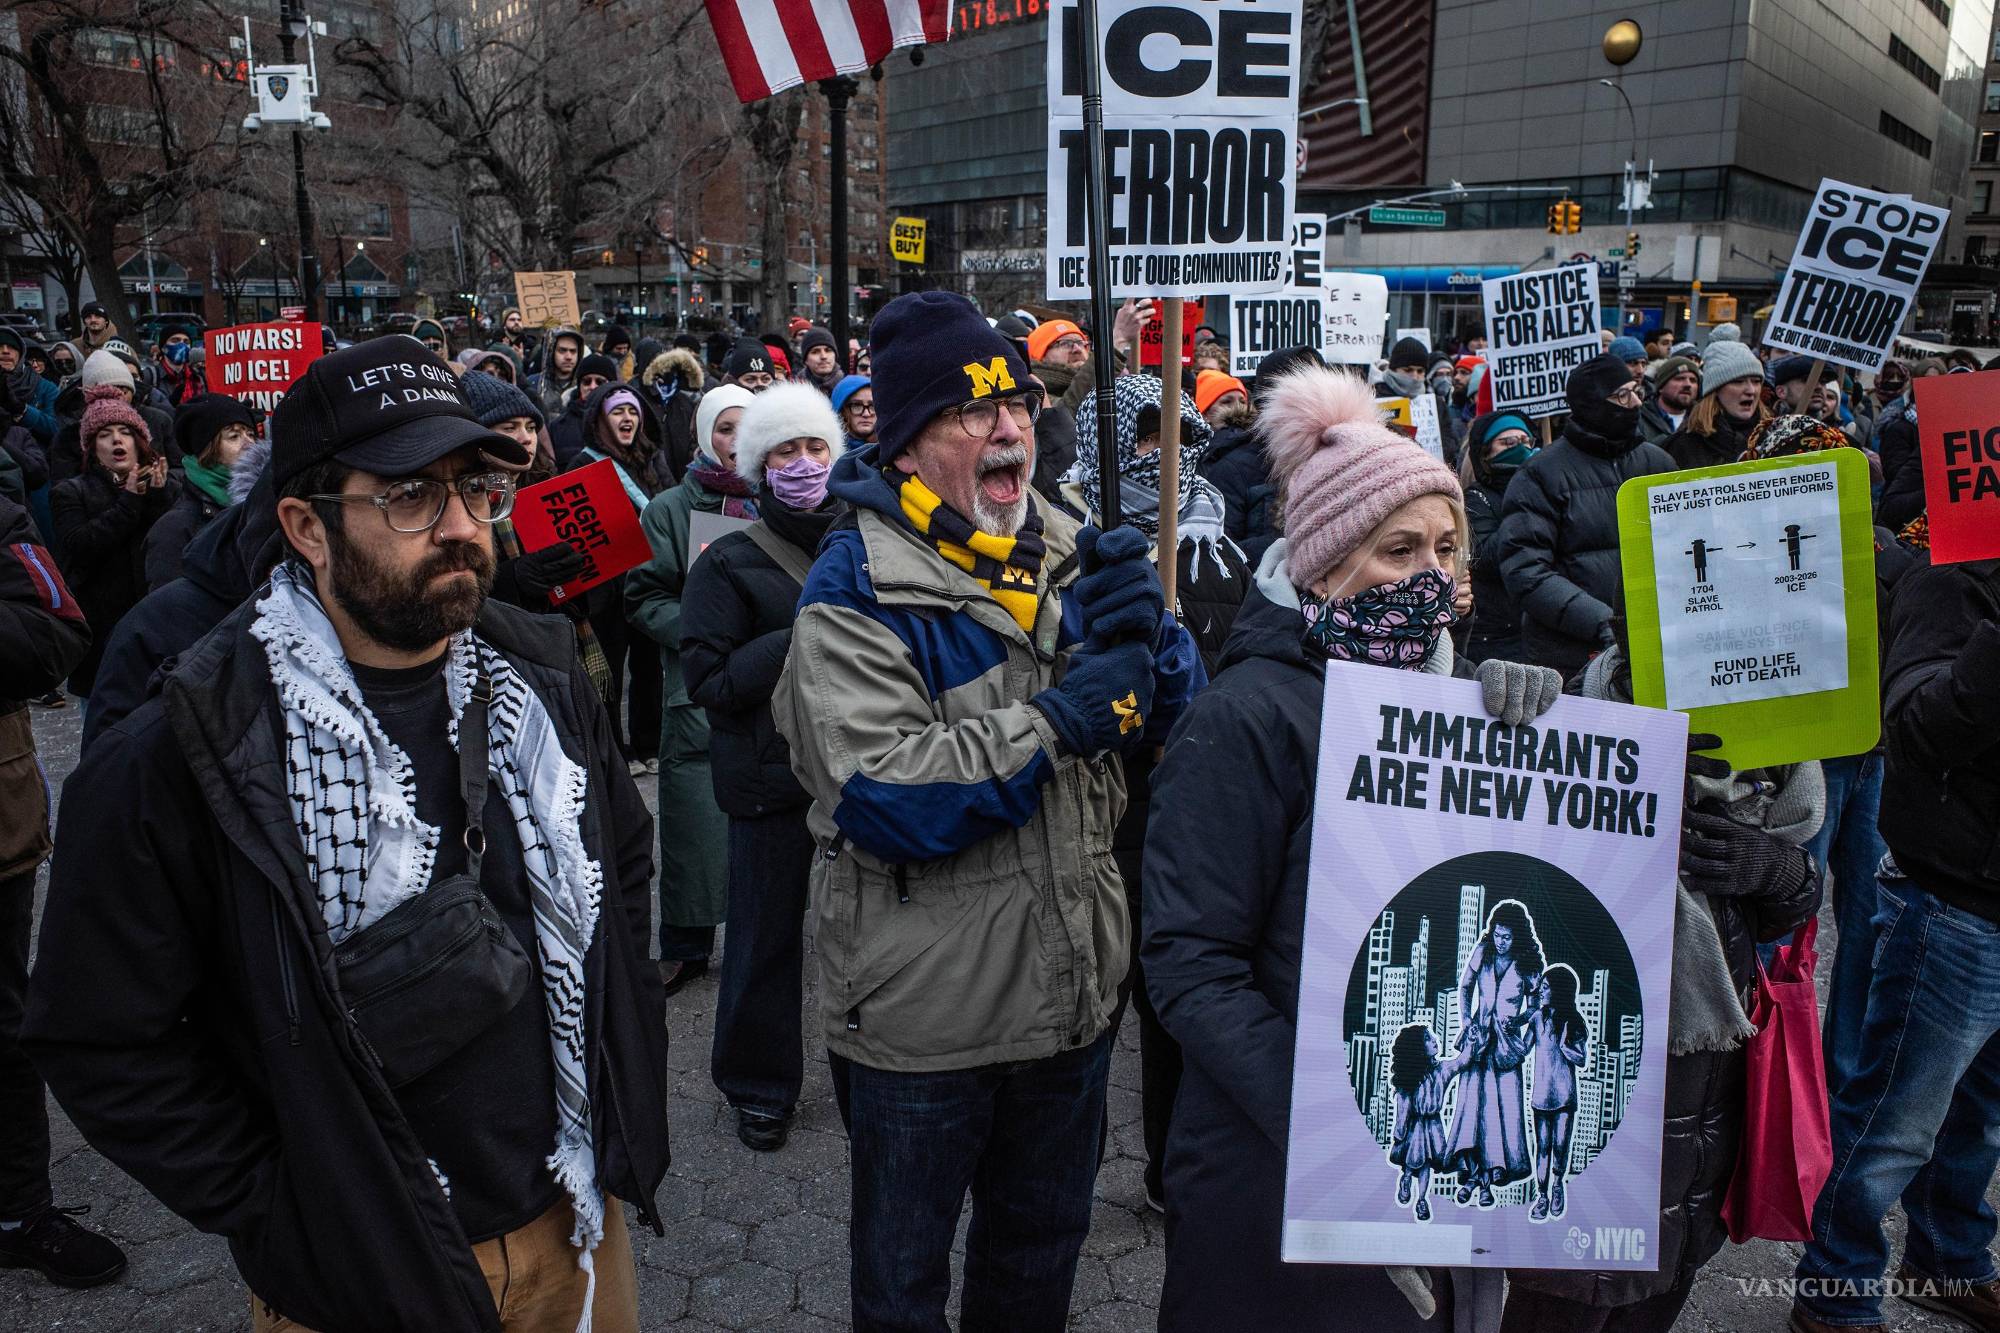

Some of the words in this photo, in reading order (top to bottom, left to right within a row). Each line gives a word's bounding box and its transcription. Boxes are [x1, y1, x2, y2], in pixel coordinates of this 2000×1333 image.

[1062, 6, 1292, 98] ICE
[1059, 128, 1286, 247] TERROR
[1818, 189, 1940, 239] STOP
[895, 224, 924, 240] BEST
[895, 239, 920, 255] BUY
[1801, 216, 1930, 286] ICE
[1059, 256, 1085, 288] ICE
[1122, 254, 1143, 286] OF
[1145, 254, 1181, 286] OUR
[1182, 250, 1282, 284] COMMUNITIES
[159, 283, 182, 294] Office
[520, 279, 550, 325] ICE!
[1495, 267, 1590, 315] JUSTICE
[1235, 299, 1322, 353] TERROR
[1492, 311, 1539, 349] FOR
[1542, 302, 1596, 342] ALEX
[1780, 269, 1906, 350] TERROR
[215, 332, 235, 356] NO
[236, 327, 303, 351] WARS!
[1770, 326, 1784, 343] ICE
[1784, 329, 1802, 347] OUT
[1800, 333, 1812, 350] OF
[1811, 336, 1832, 356] OUR
[1829, 341, 1882, 368] COMMUNITIES
[224, 361, 243, 385] NO
[247, 359, 290, 382] ICE!
[420, 363, 457, 389] GIVE
[1236, 355, 1247, 371] ICE
[1247, 355, 1259, 371] OUT
[1494, 351, 1552, 378] JEFFREY
[1553, 342, 1599, 367] PRETTI
[963, 356, 1017, 398] M
[1496, 374, 1548, 403] KILLED
[1549, 370, 1568, 396] BY
[380, 392, 398, 410] A
[402, 386, 461, 405] DAMN
[1651, 502, 1686, 515] THEY
[1683, 498, 1712, 511] JUST
[1714, 490, 1771, 506] CHANGED
[1774, 481, 1835, 498] UNIFORMS
[1653, 490, 1695, 504] SLAVE
[1693, 482, 1746, 499] PATROLS
[1749, 477, 1788, 491] NEVER
[1790, 471, 1831, 485] ENDED
[562, 482, 611, 550] FIGHT
[1001, 562, 1036, 586] M
[1690, 584, 1715, 595] 1704
[1774, 571, 1818, 585] 2003-2026
[1787, 581, 1807, 593] ICE
[1685, 602, 1724, 614] PATROL
[1688, 595, 1719, 606] SLAVE
[1695, 628, 1736, 643] SAME
[1740, 618, 1812, 637] VIOLENCE
[1703, 639, 1743, 654] SAME
[1746, 633, 1805, 649] SYSTEM
[1710, 672, 1743, 687] NOT
[1748, 664, 1801, 682] DEATH
[1714, 657, 1758, 674] FUND
[1762, 652, 1797, 668] LIFE
[1376, 703, 1640, 785] IMMIGRANTS
[1345, 754, 1430, 810] ARE
[1439, 765, 1533, 822] NEW
[1542, 778, 1658, 838] YORK!
[1594, 1227, 1646, 1261] NYIC
